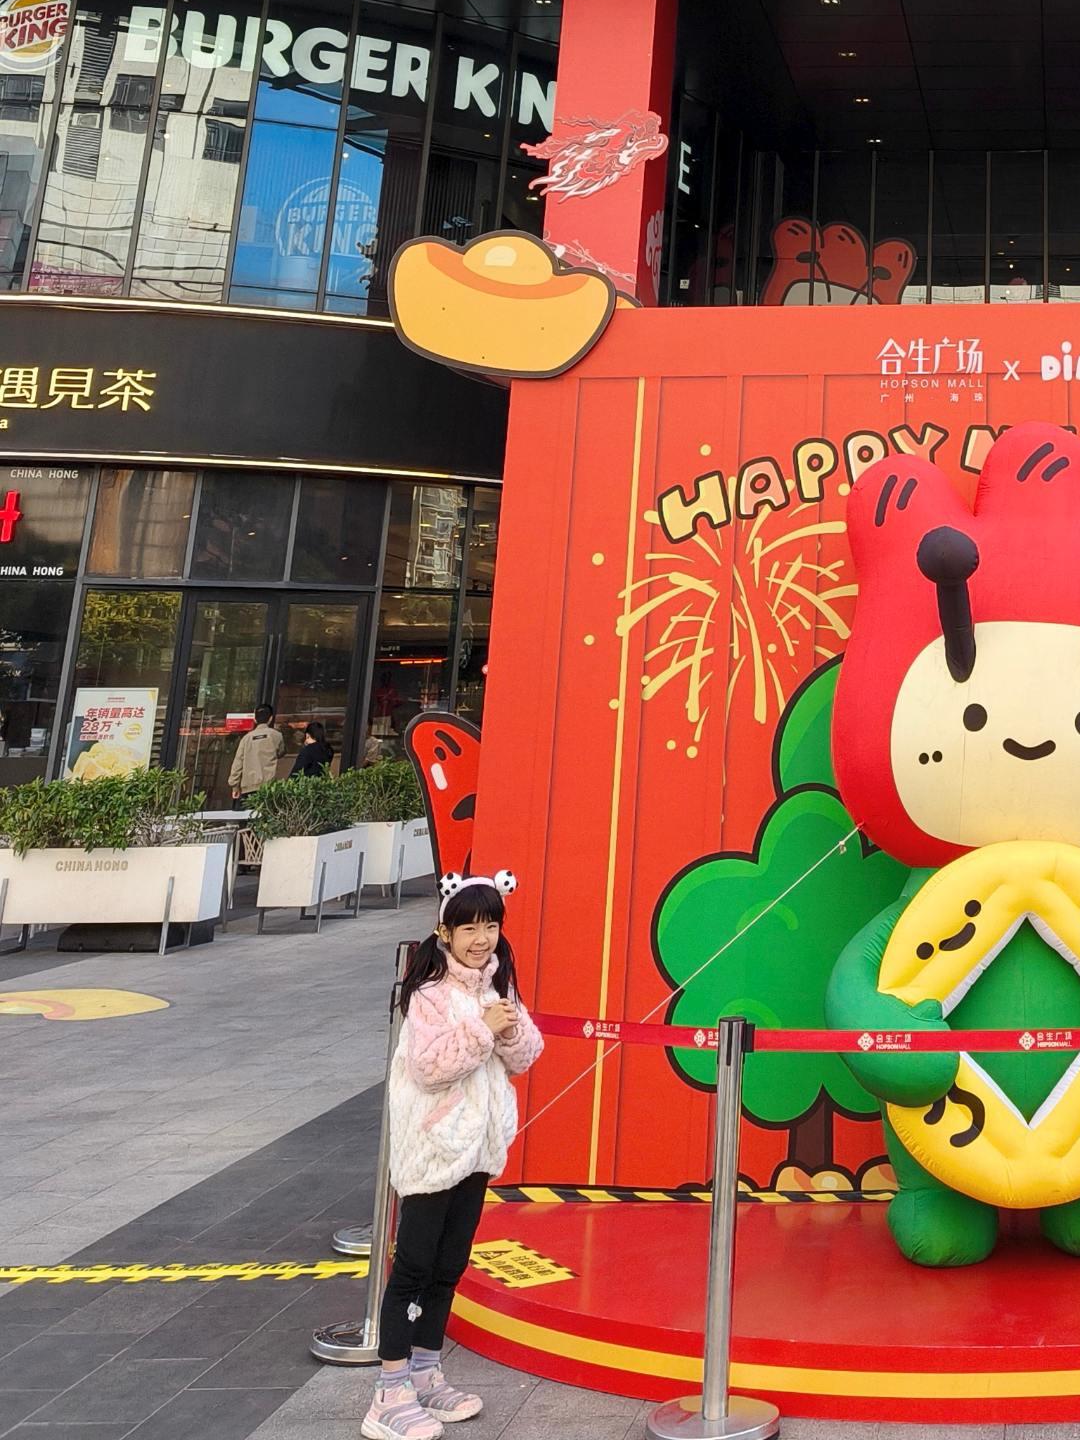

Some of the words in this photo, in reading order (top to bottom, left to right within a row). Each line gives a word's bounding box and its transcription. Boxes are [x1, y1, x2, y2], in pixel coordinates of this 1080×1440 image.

[123, 5, 430, 103] BURGER
[875, 336, 984, 375] 合生广场
[879, 379, 940, 389] HOPSON
[947, 379, 984, 389] MALL
[10, 469, 43, 479] CHINA
[48, 469, 79, 479] HONG
[657, 423, 949, 543] HAPPY
[0, 566, 27, 576] HINA
[32, 566, 64, 576] HONG
[85, 707, 145, 719] 年销量高达
